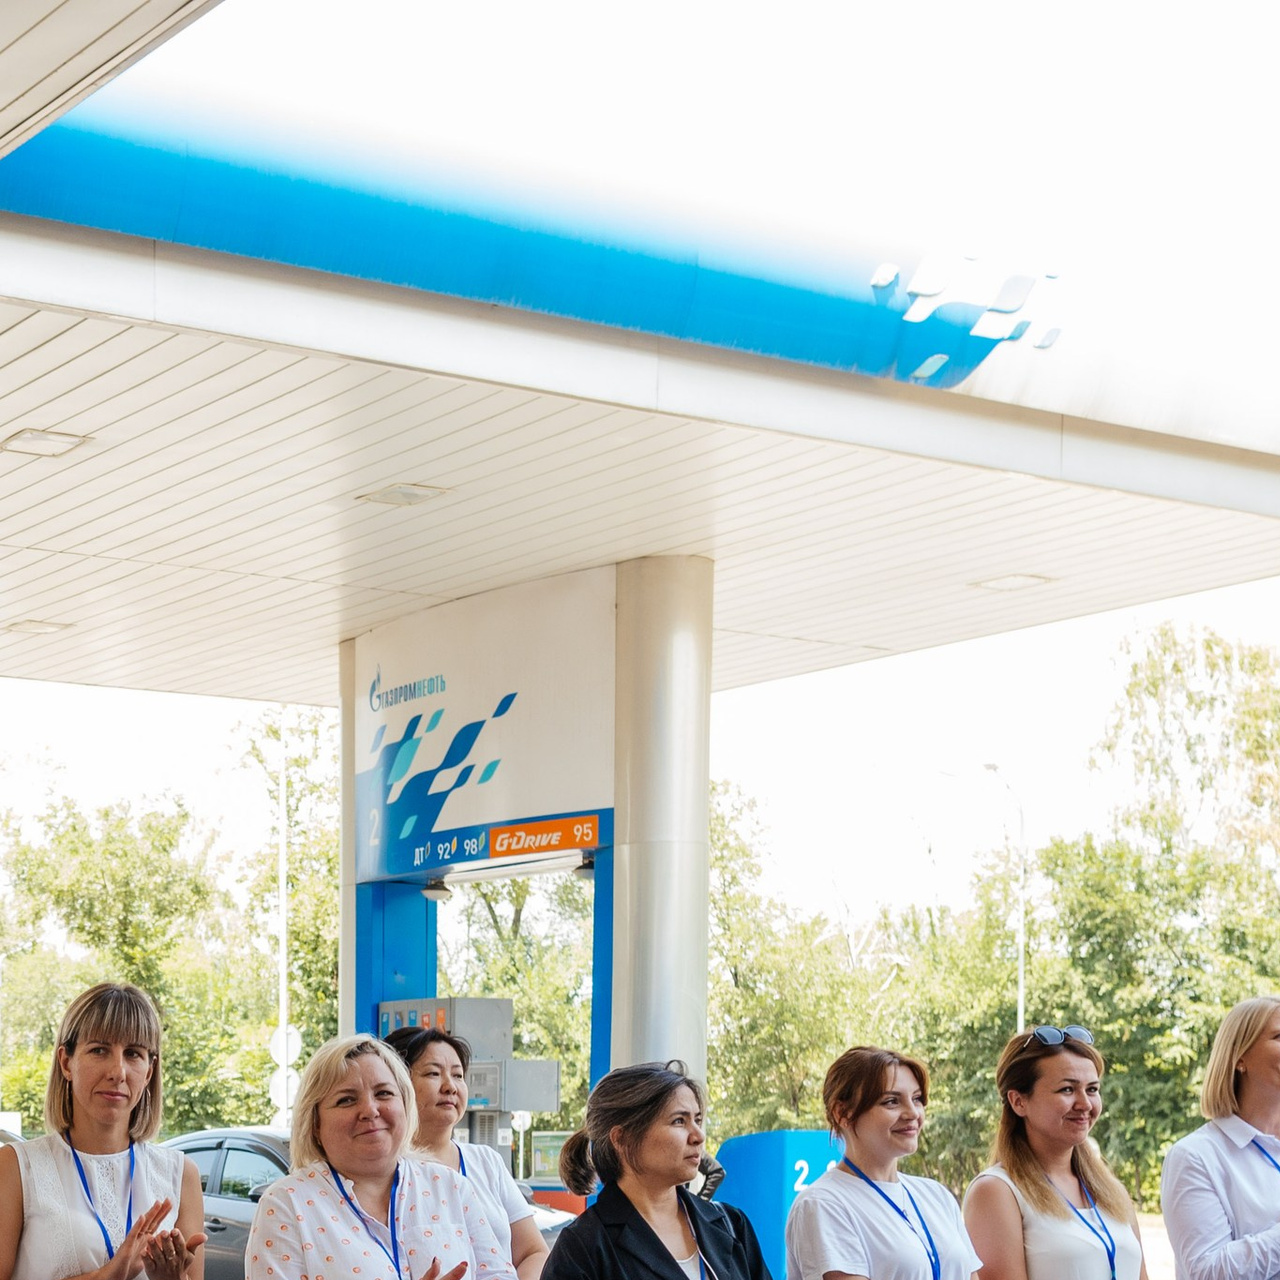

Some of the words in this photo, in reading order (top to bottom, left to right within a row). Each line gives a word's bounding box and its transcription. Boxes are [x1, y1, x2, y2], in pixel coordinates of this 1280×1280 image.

[381, 674, 446, 709] ГАЗПРОМНЕФТЬ
[370, 808, 380, 846] 2
[437, 842, 451, 860] 92
[463, 838, 478, 856] 98
[573, 822, 593, 842] 95
